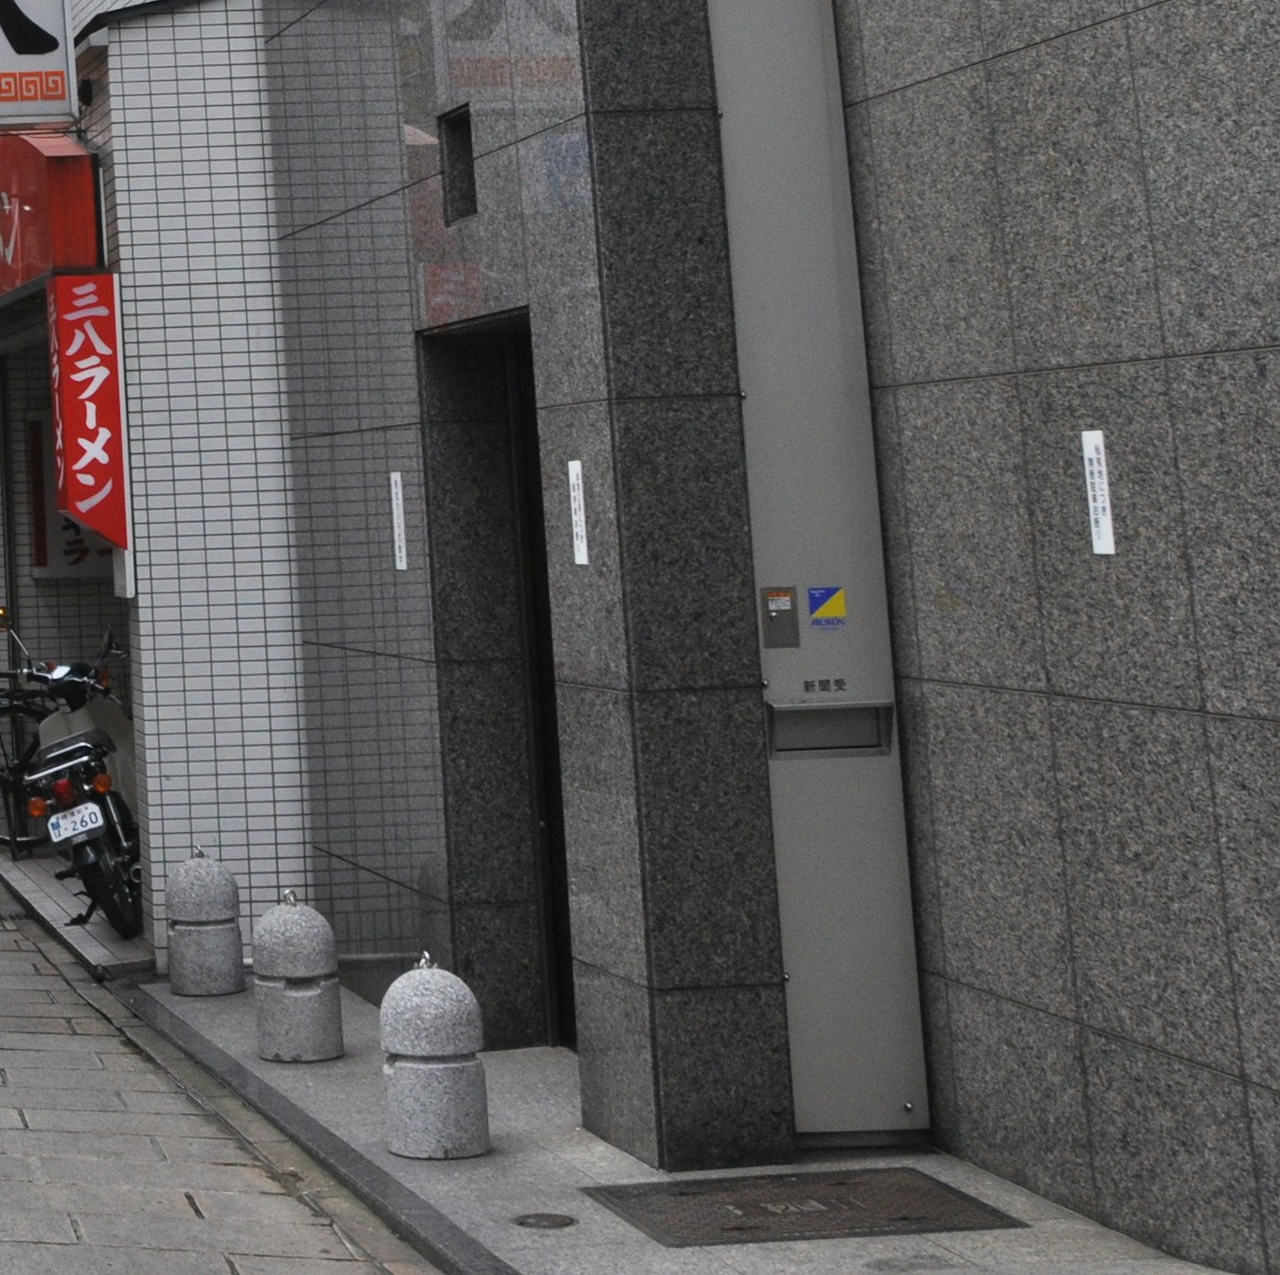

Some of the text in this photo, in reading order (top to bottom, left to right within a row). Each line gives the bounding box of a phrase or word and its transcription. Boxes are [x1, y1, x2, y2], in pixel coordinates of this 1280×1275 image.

[62, 281, 114, 513] 三八ラーメン
[803, 678, 848, 693] 新聞受
